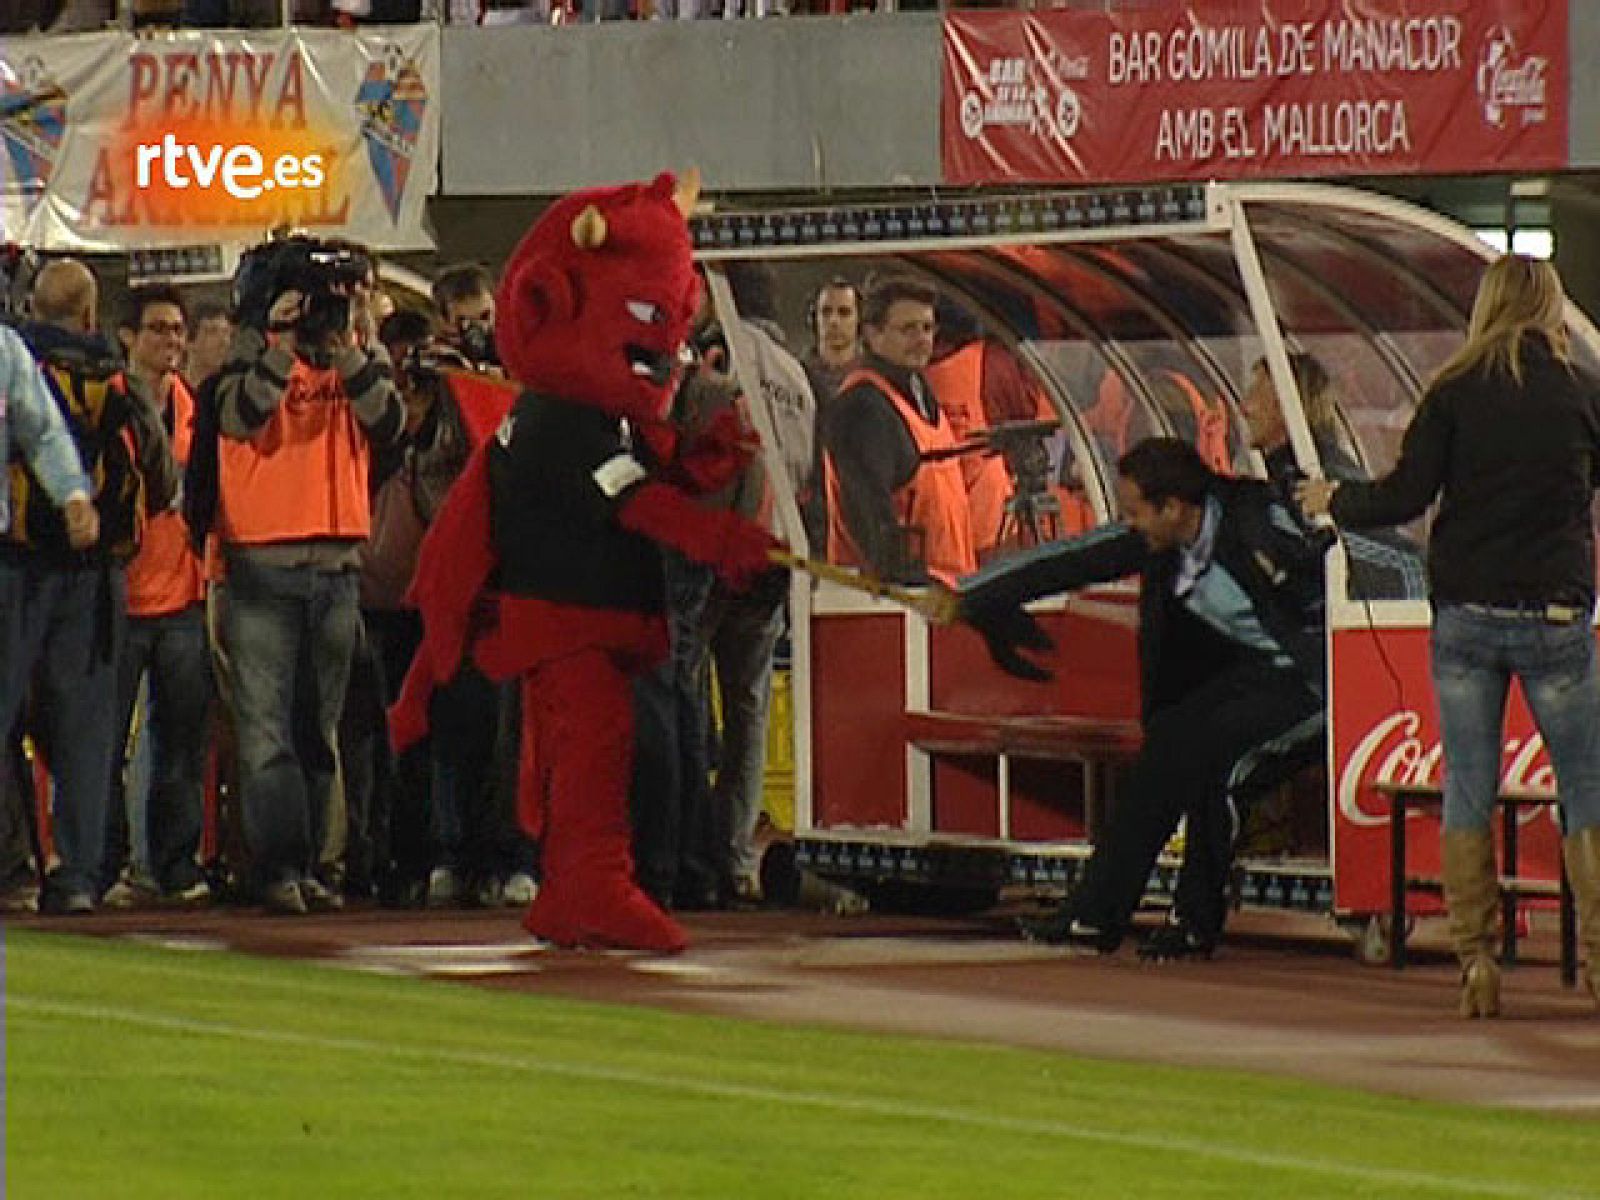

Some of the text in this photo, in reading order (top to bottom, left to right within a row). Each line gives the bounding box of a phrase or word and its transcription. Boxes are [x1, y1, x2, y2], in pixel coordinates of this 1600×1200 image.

[1109, 31, 1161, 83] BAR
[1277, 23, 1316, 75] DE
[1323, 16, 1462, 71] MANACOR
[121, 52, 307, 130] PENYA
[1155, 99, 1411, 161] AMB EL MALLORCA
